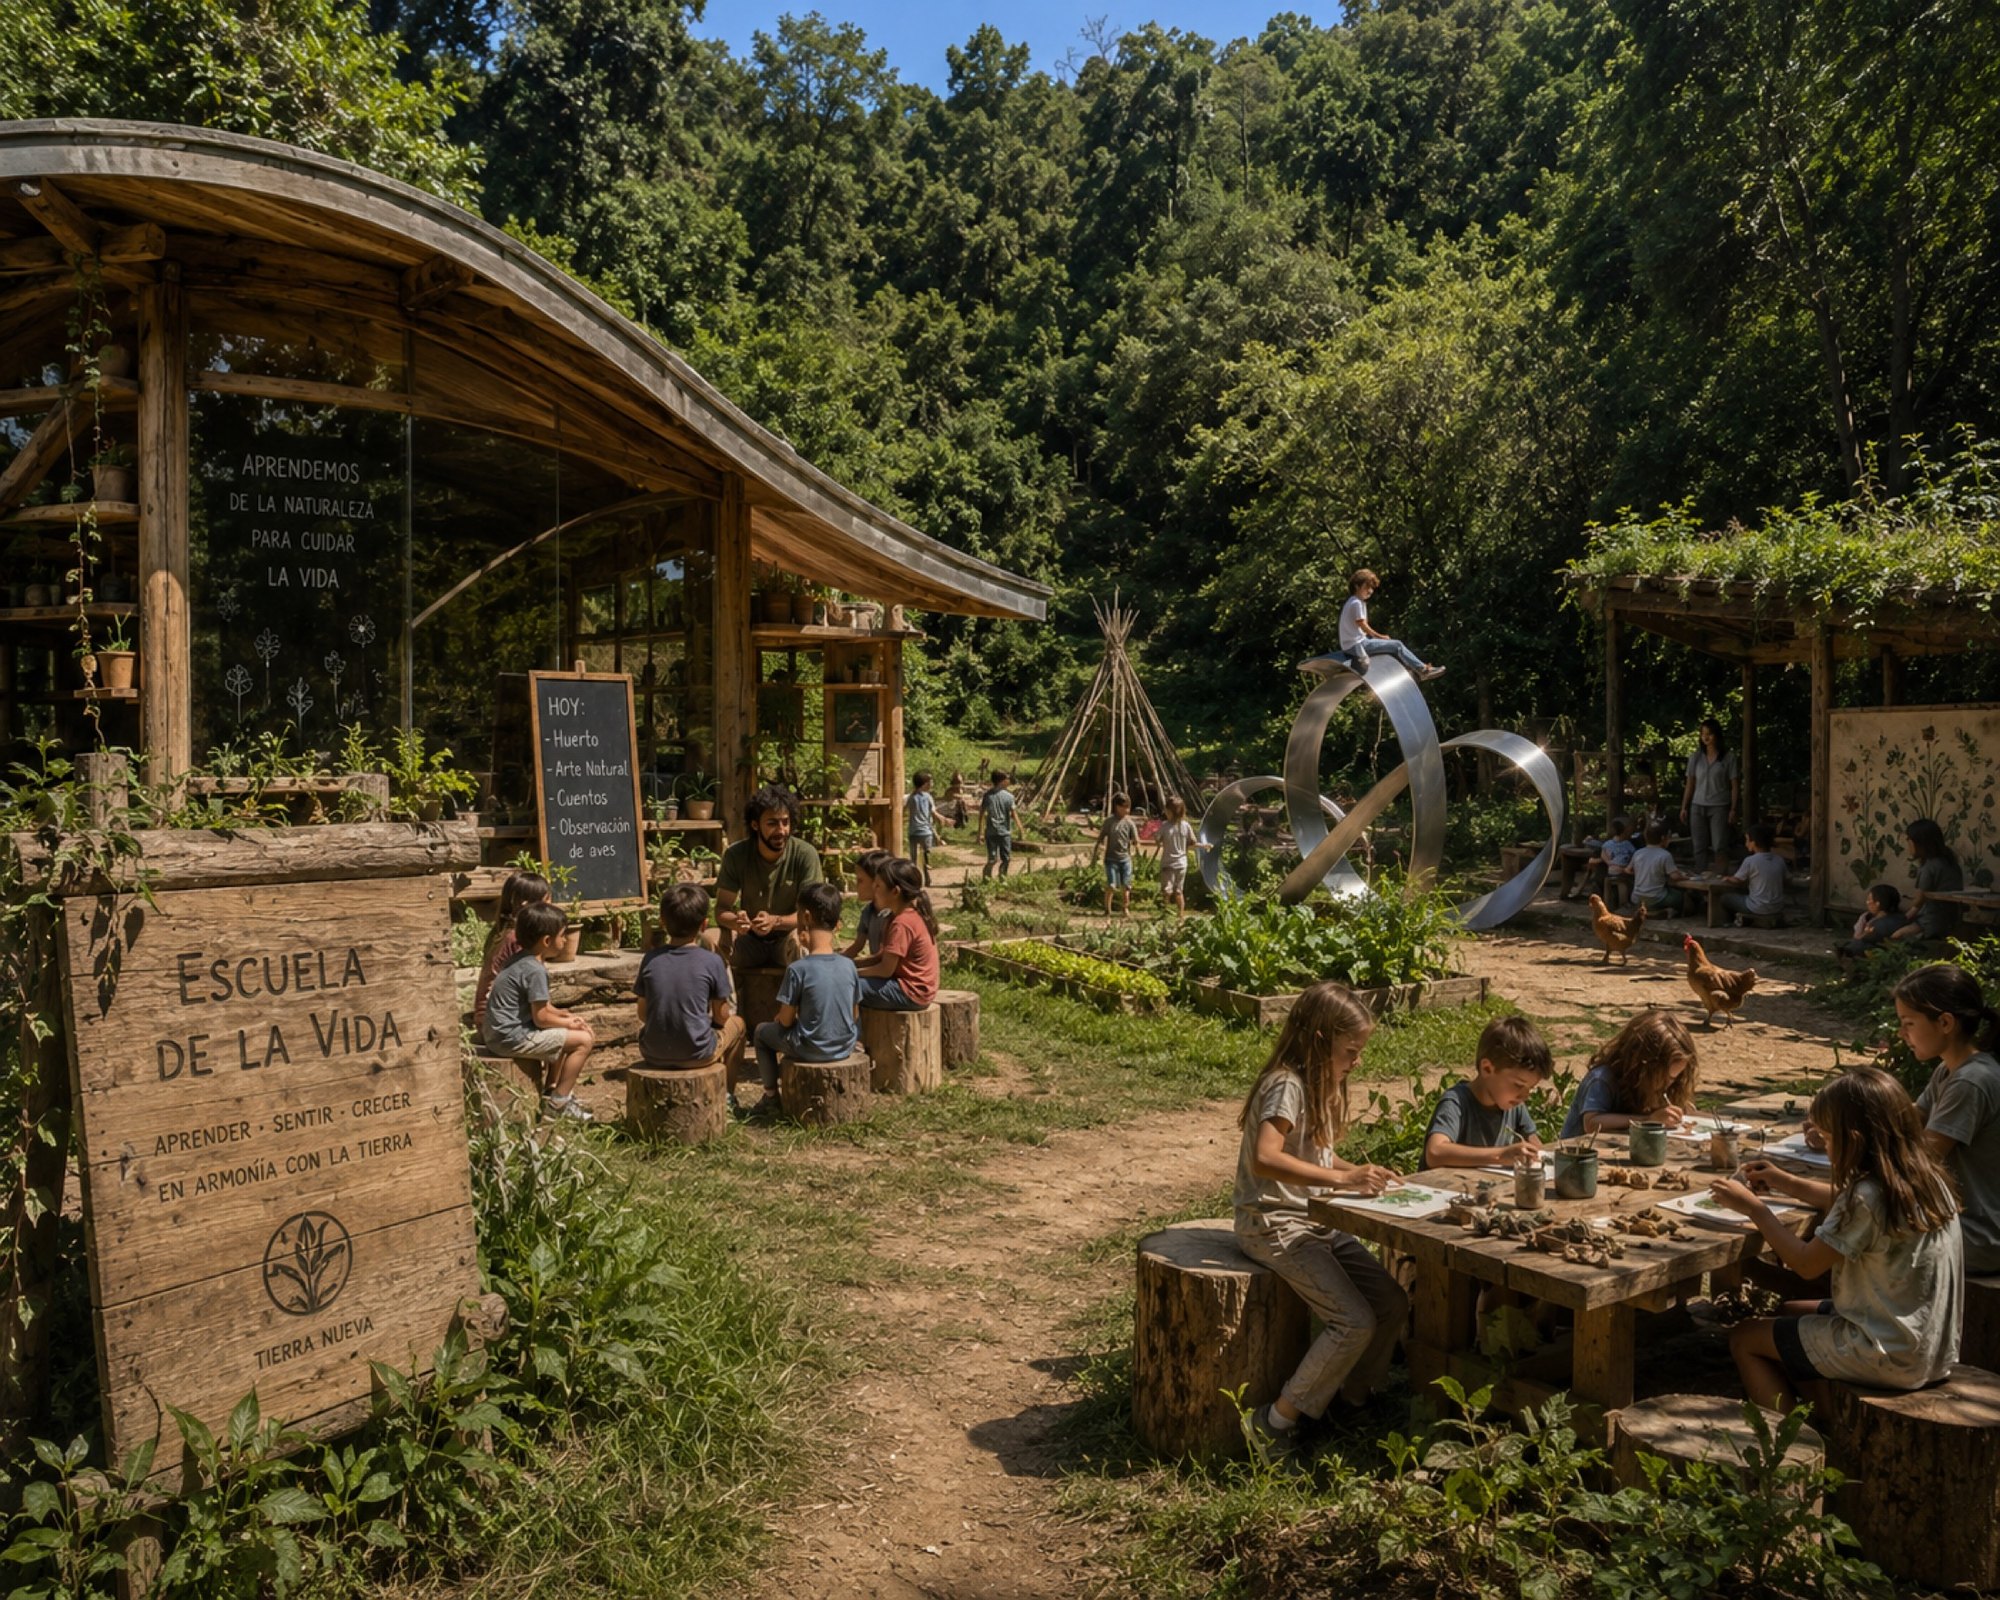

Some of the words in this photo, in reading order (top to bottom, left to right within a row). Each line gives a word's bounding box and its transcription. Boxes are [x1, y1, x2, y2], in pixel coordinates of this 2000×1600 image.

[242, 454, 360, 484] APRENDEMOS
[230, 492, 249, 511] DE
[258, 494, 276, 513] LA
[285, 497, 374, 519] NATURALEZA
[252, 529, 291, 549] PARA
[301, 531, 355, 553] CUIDAR
[268, 566, 289, 587] LA
[299, 568, 339, 588] VIDA
[548, 697, 585, 716] HOY:
[553, 729, 599, 748] Huerto
[555, 760, 581, 777] Arte
[585, 759, 629, 777] Natural
[557, 789, 608, 807] Cuentos
[569, 843, 584, 859] de
[589, 844, 616, 858] aves
[176, 948, 367, 1006] ESCUELA
[156, 1034, 213, 1081] DE
[238, 1025, 290, 1071] LA
[309, 1009, 402, 1058] VIDA
[154, 1121, 251, 1157] APRENDER
[273, 1106, 333, 1133] SENTIR
[351, 1092, 412, 1118] CRECER
[159, 1180, 184, 1203] EN
[285, 1156, 320, 1175] CON
[329, 1145, 350, 1166] LA
[358, 1132, 413, 1159] TIERRA
[253, 1336, 314, 1370] TIERRA
[321, 1316, 374, 1348] NUEVA
